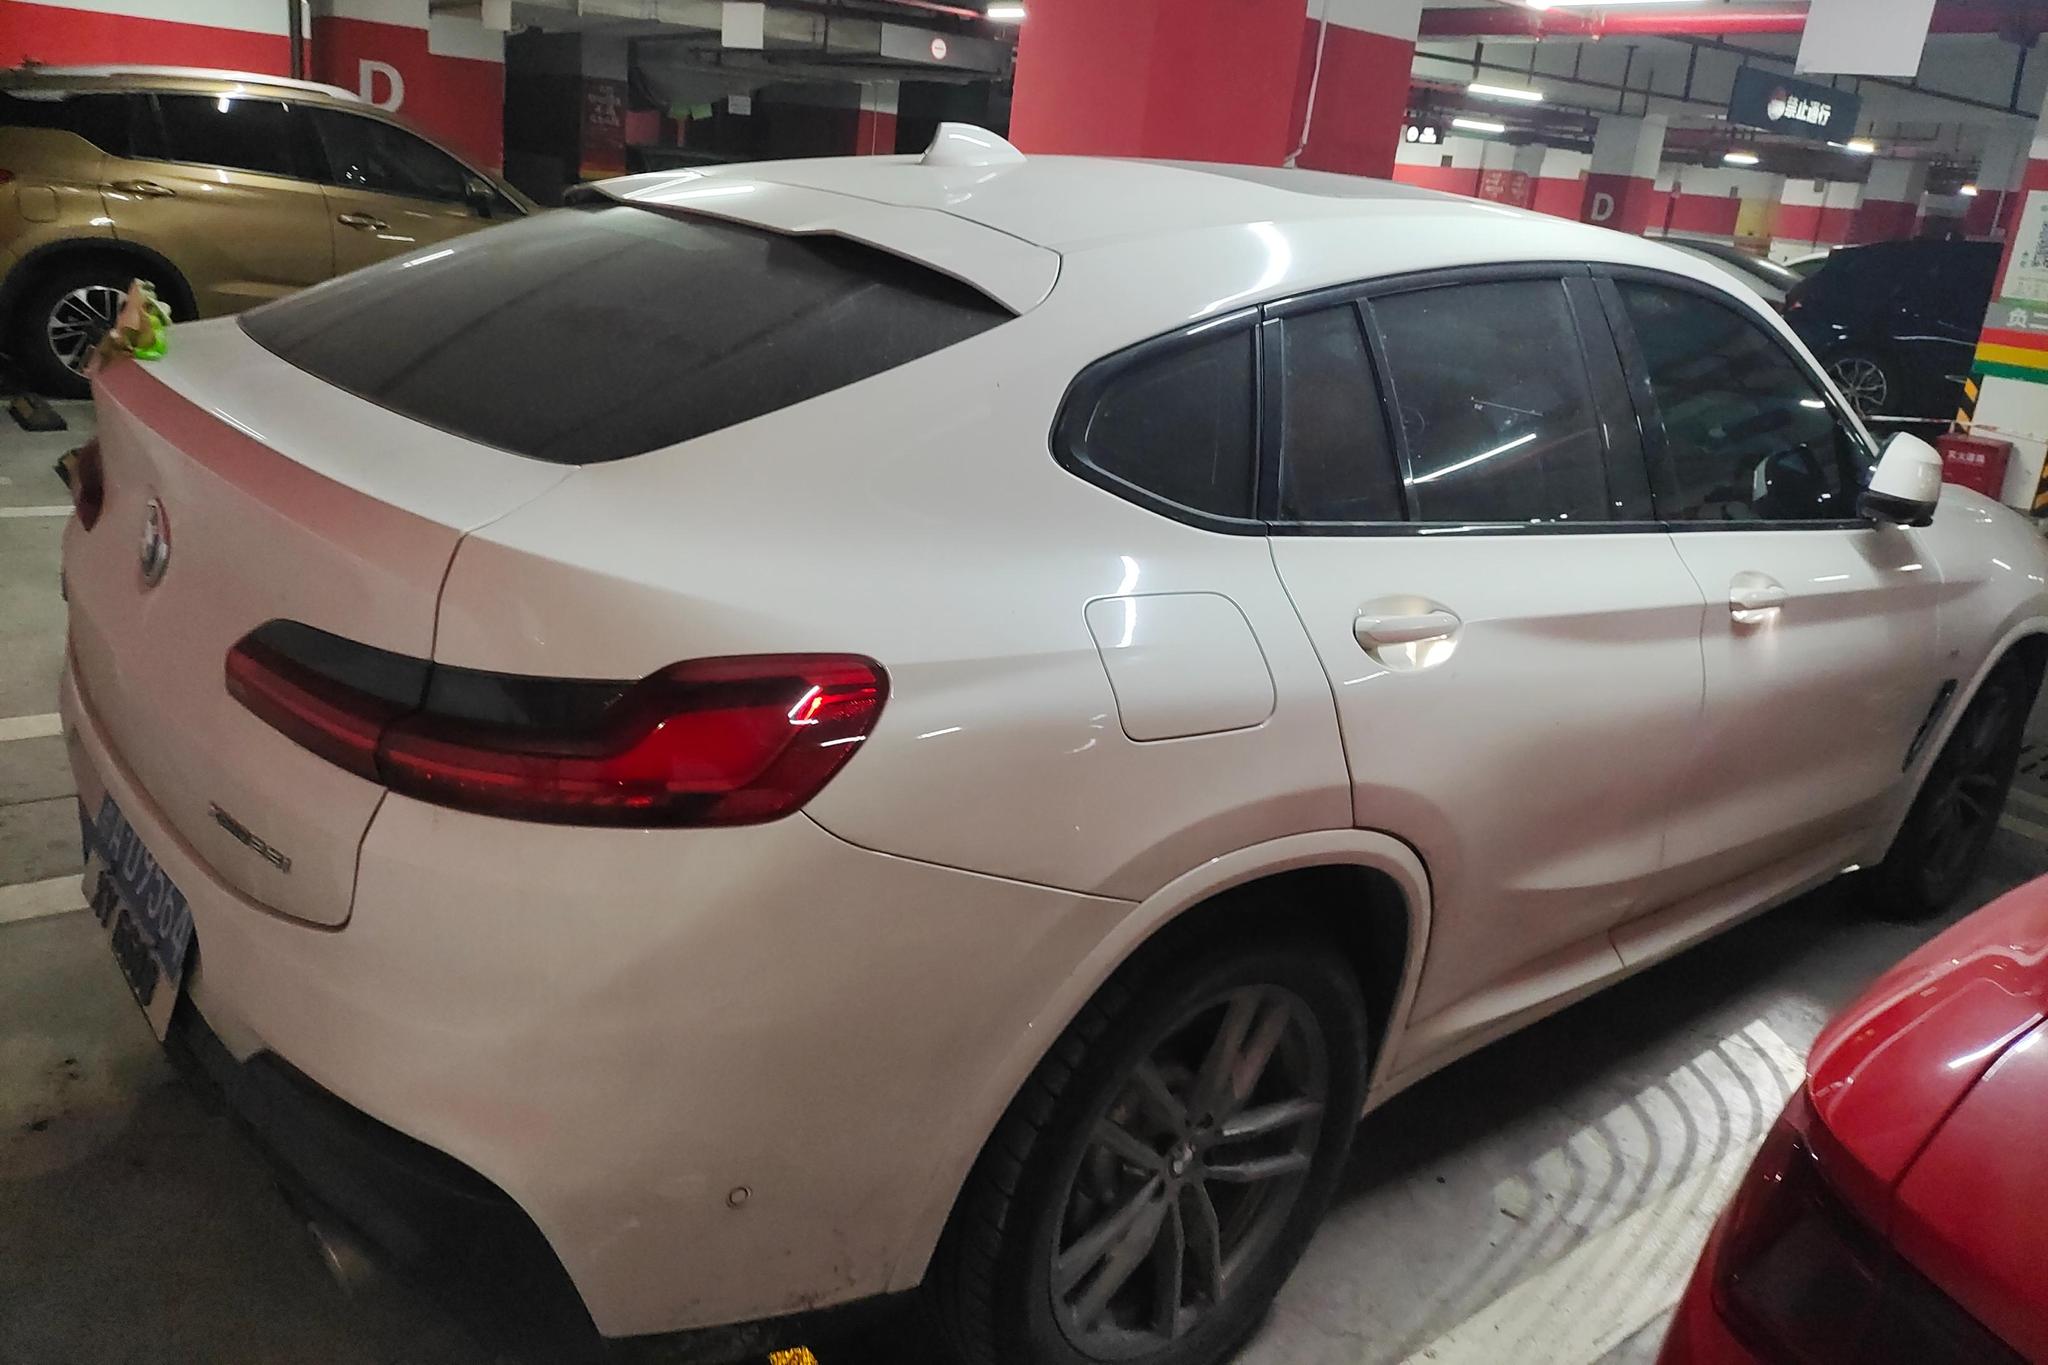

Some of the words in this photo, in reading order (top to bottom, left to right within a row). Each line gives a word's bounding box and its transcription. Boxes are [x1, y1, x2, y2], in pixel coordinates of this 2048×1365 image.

[359, 58, 405, 113] D
[1784, 94, 1832, 126] 禁止通行
[1591, 192, 1615, 221] D
